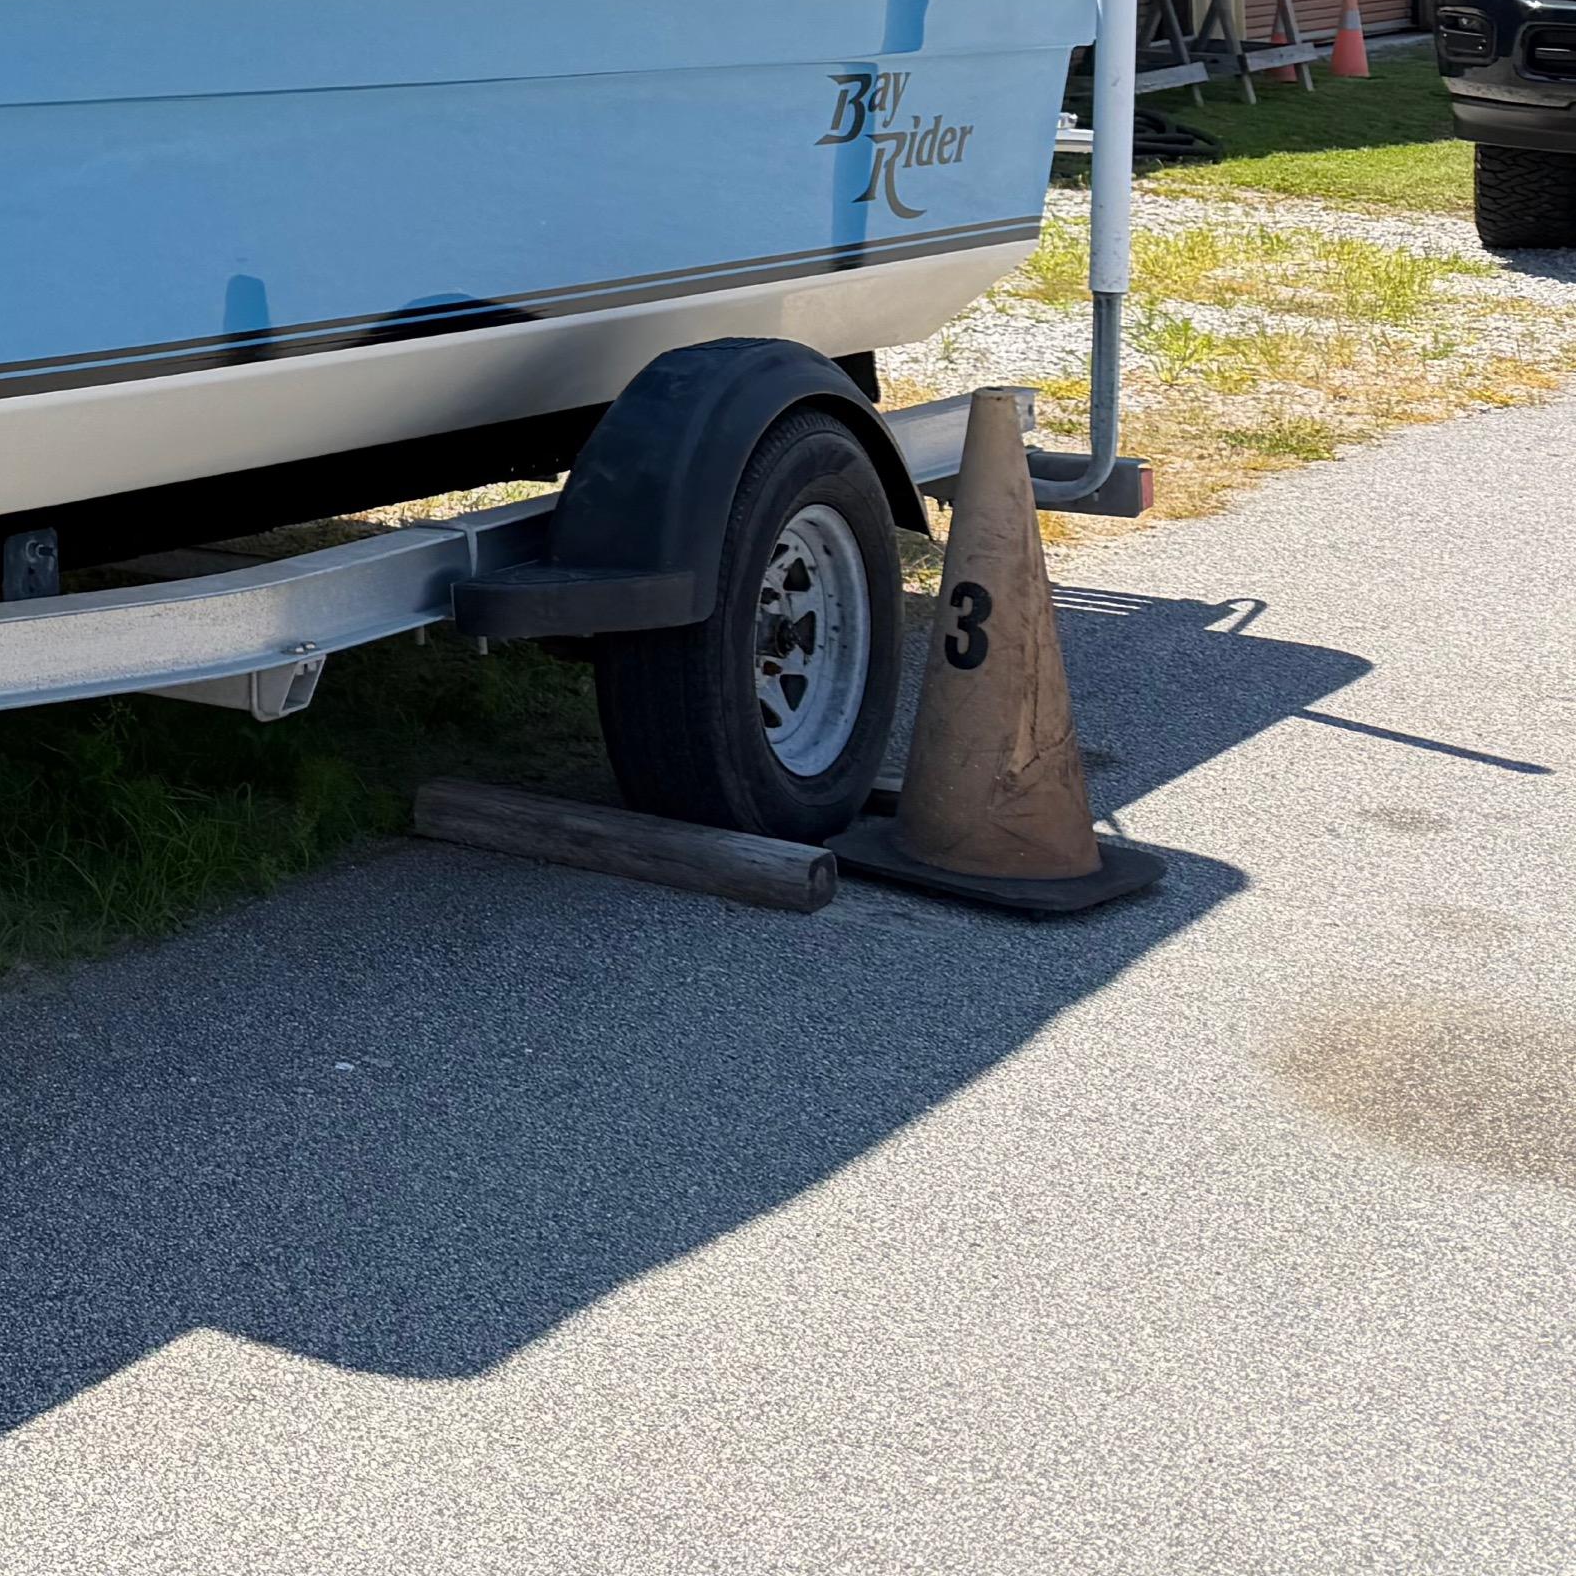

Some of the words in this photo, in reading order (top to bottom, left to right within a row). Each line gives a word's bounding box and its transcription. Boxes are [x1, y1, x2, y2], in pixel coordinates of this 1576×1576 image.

[814, 72, 911, 145] Bay
[851, 115, 974, 219] Rider
[945, 581, 992, 670] 3
